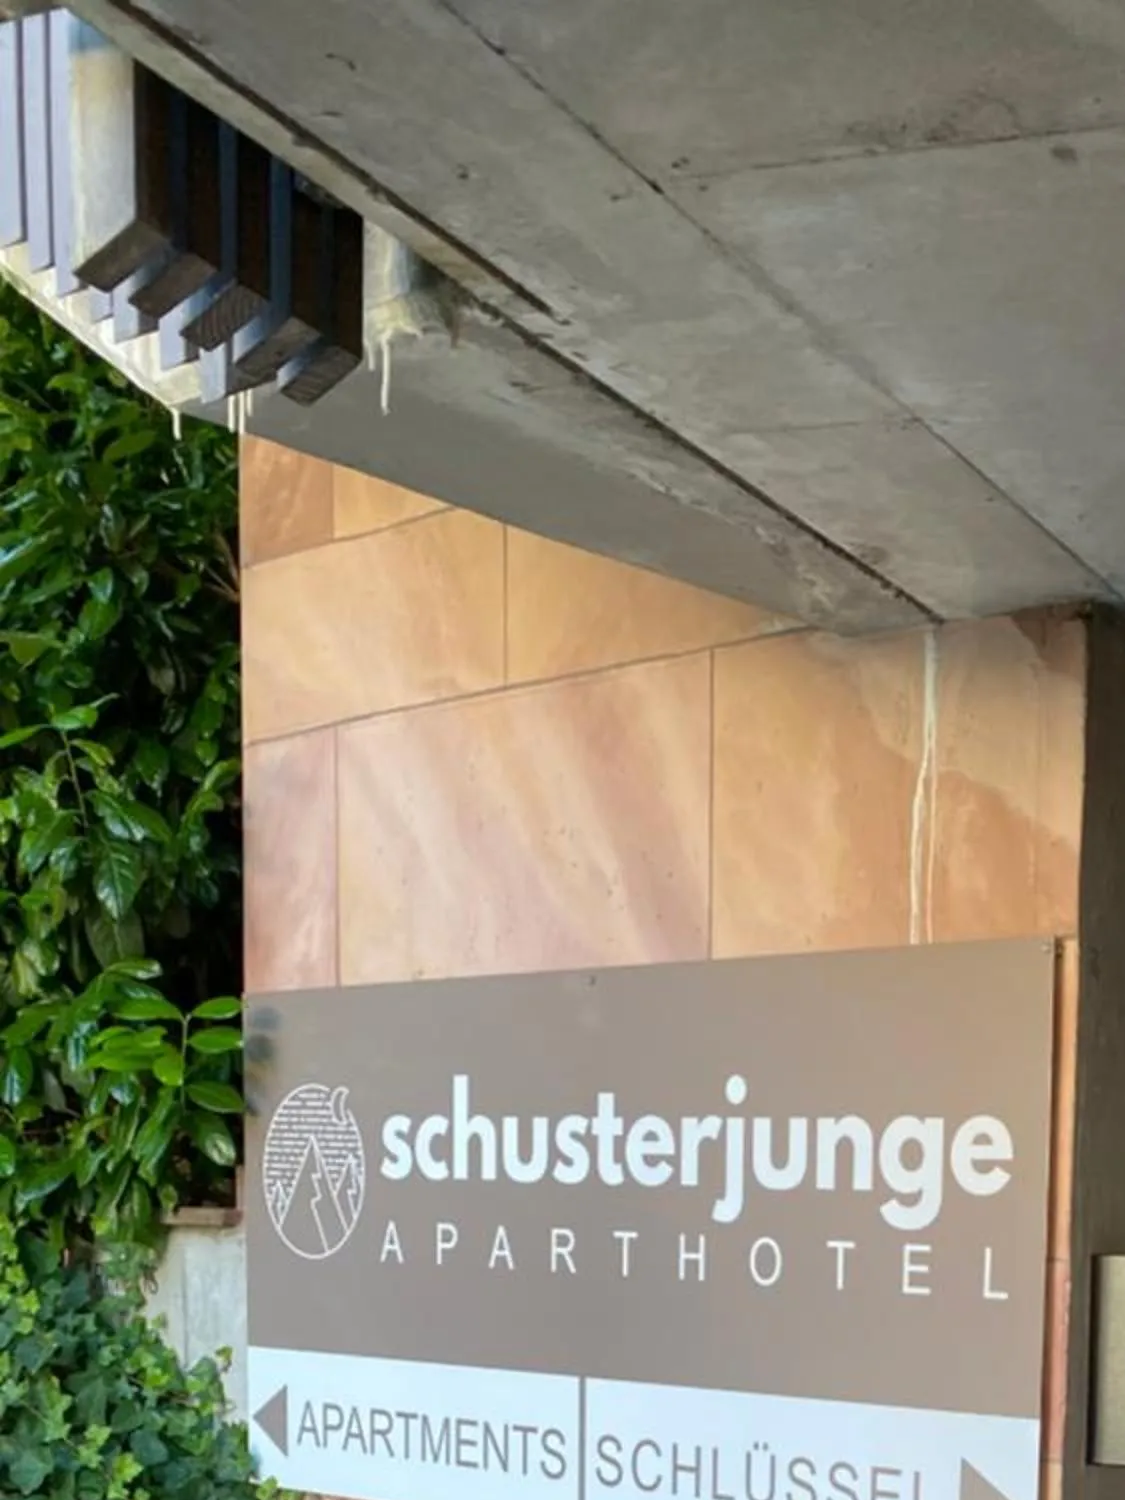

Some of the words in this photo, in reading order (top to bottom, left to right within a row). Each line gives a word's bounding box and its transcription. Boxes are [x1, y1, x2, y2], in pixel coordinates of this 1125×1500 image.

[381, 1074, 1014, 1230] schusterjunge
[380, 1221, 1009, 1301] APARTHOTEL
[297, 1400, 568, 1481] APARTMENTS
